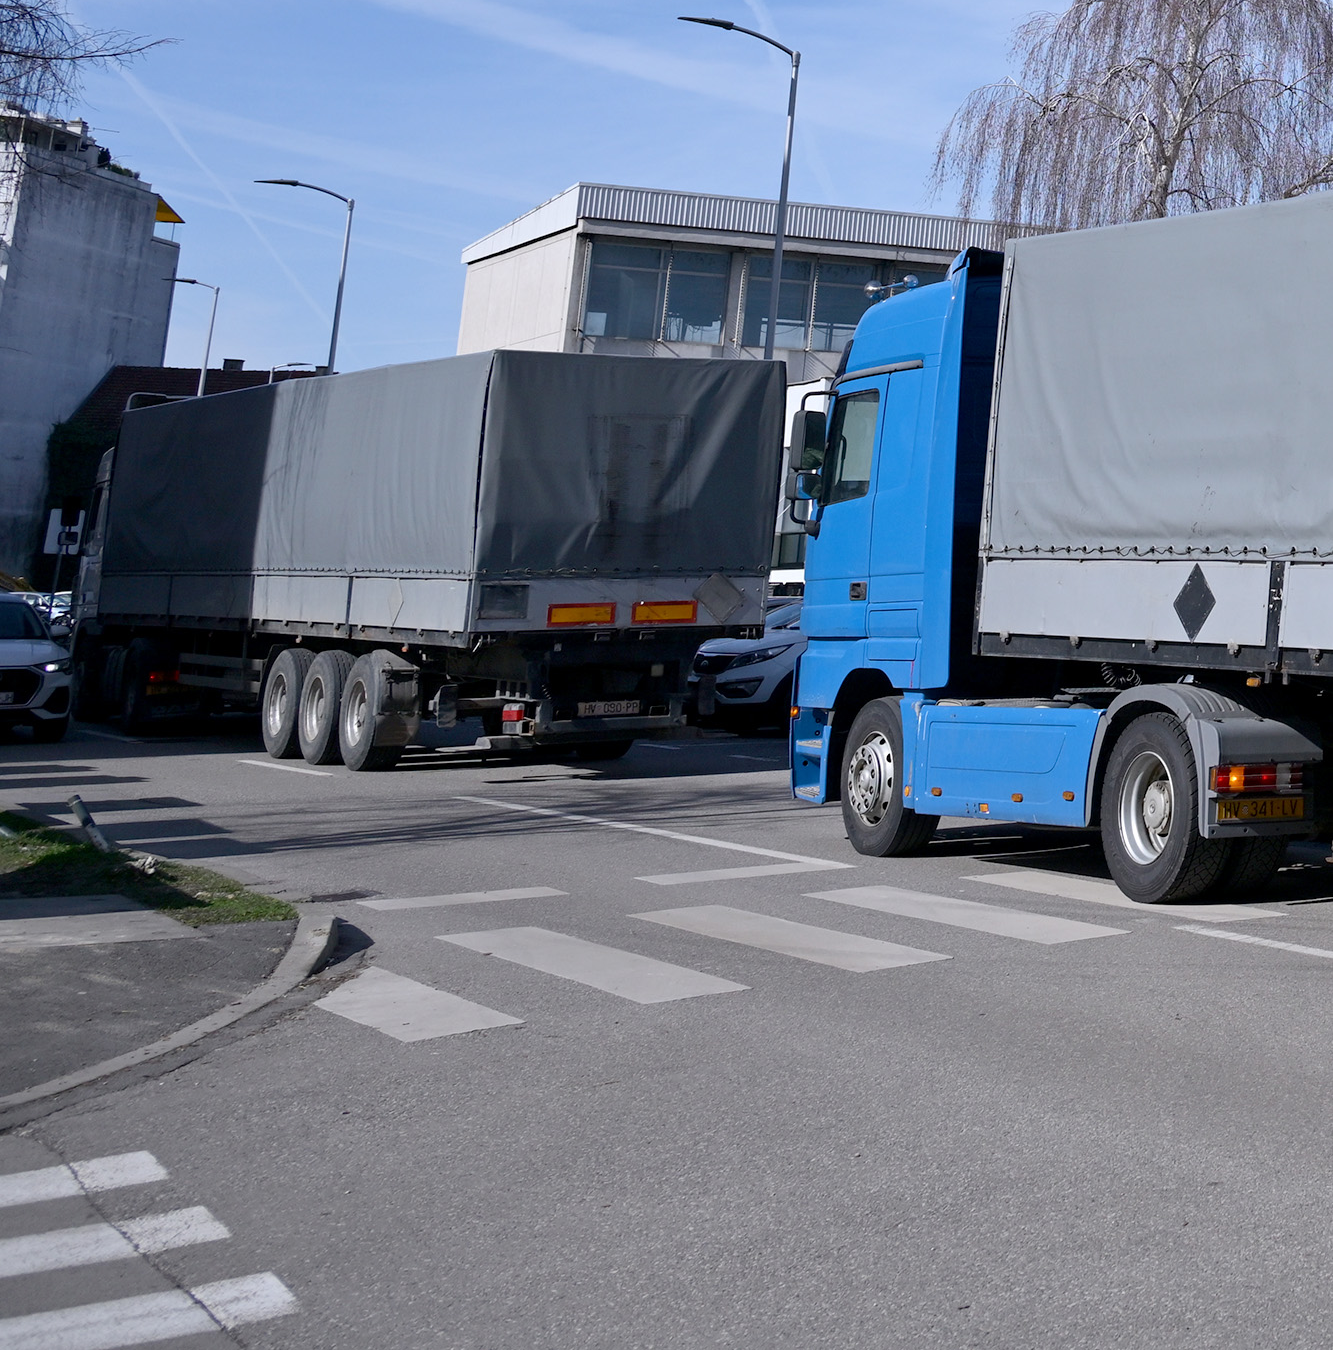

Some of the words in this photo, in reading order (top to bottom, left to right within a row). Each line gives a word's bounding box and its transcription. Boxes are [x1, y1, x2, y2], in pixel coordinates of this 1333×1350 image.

[584, 704, 597, 714] HV
[1224, 802, 1240, 819] HV
[1250, 800, 1298, 818] 341-LV
